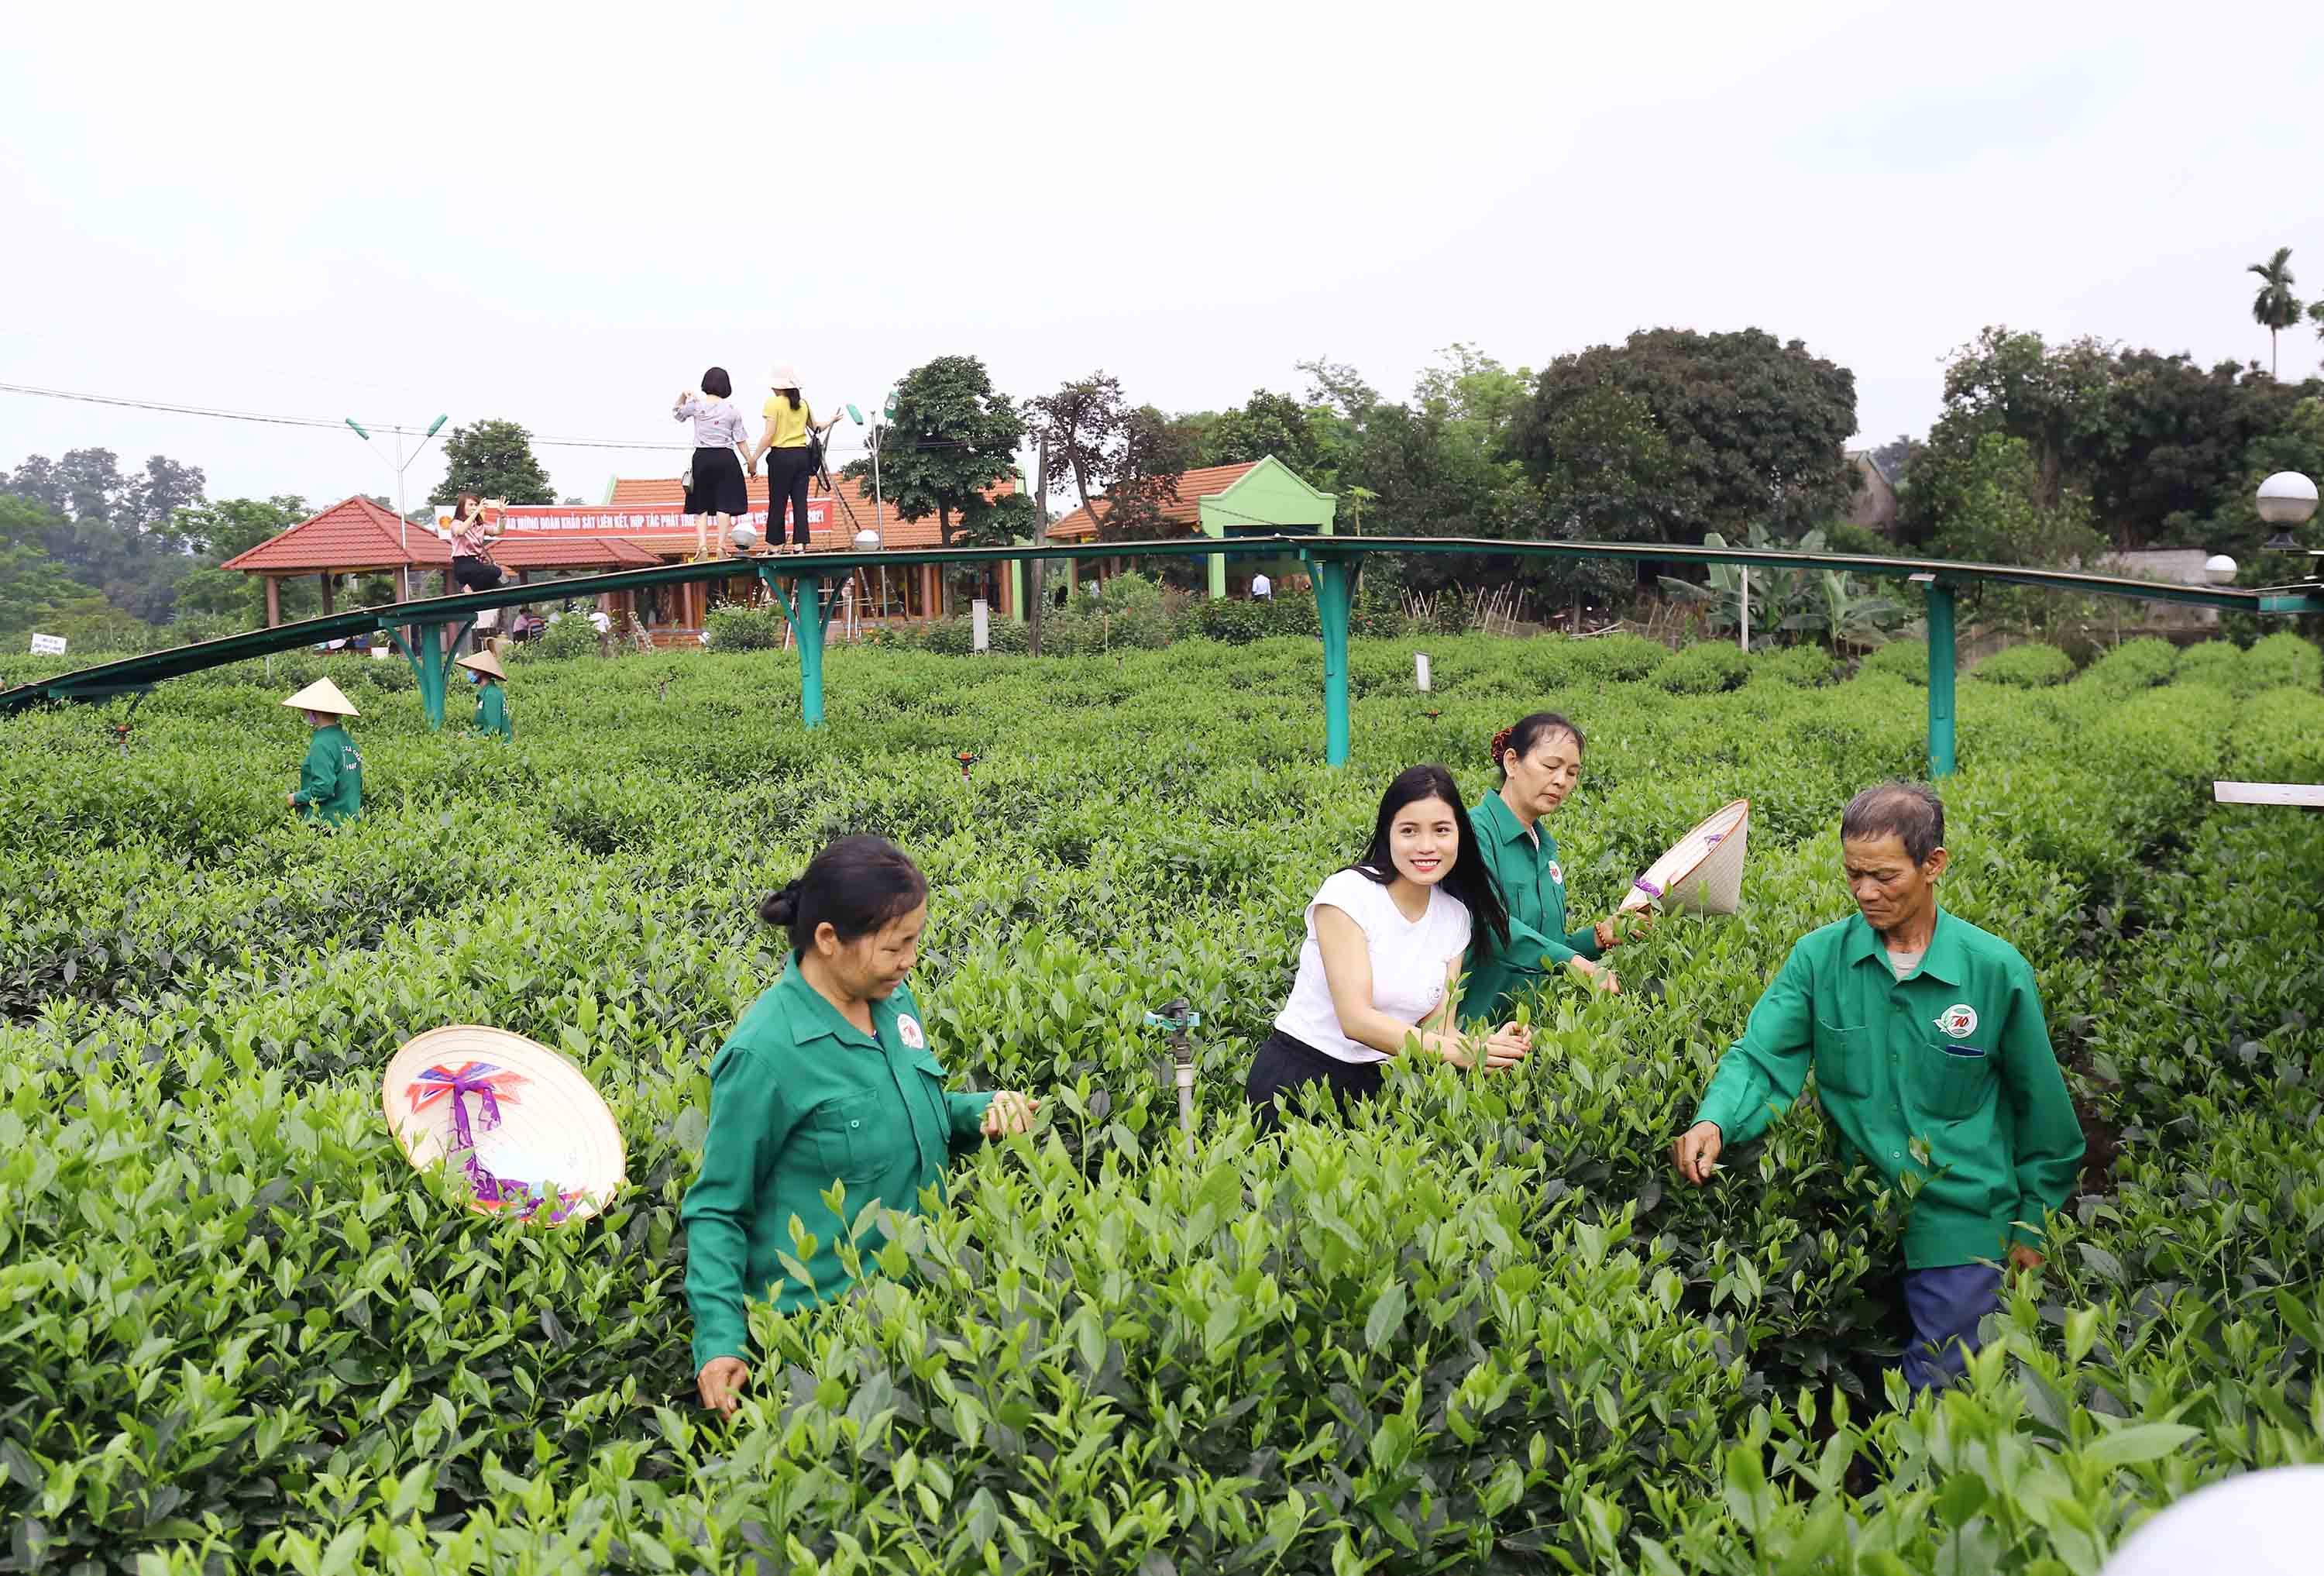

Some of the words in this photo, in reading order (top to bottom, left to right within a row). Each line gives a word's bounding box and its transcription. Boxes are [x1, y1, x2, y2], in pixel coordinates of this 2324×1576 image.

[582, 514, 595, 529] SÁT
[645, 512, 660, 528] TÁC
[661, 511, 679, 528] PHÁT
